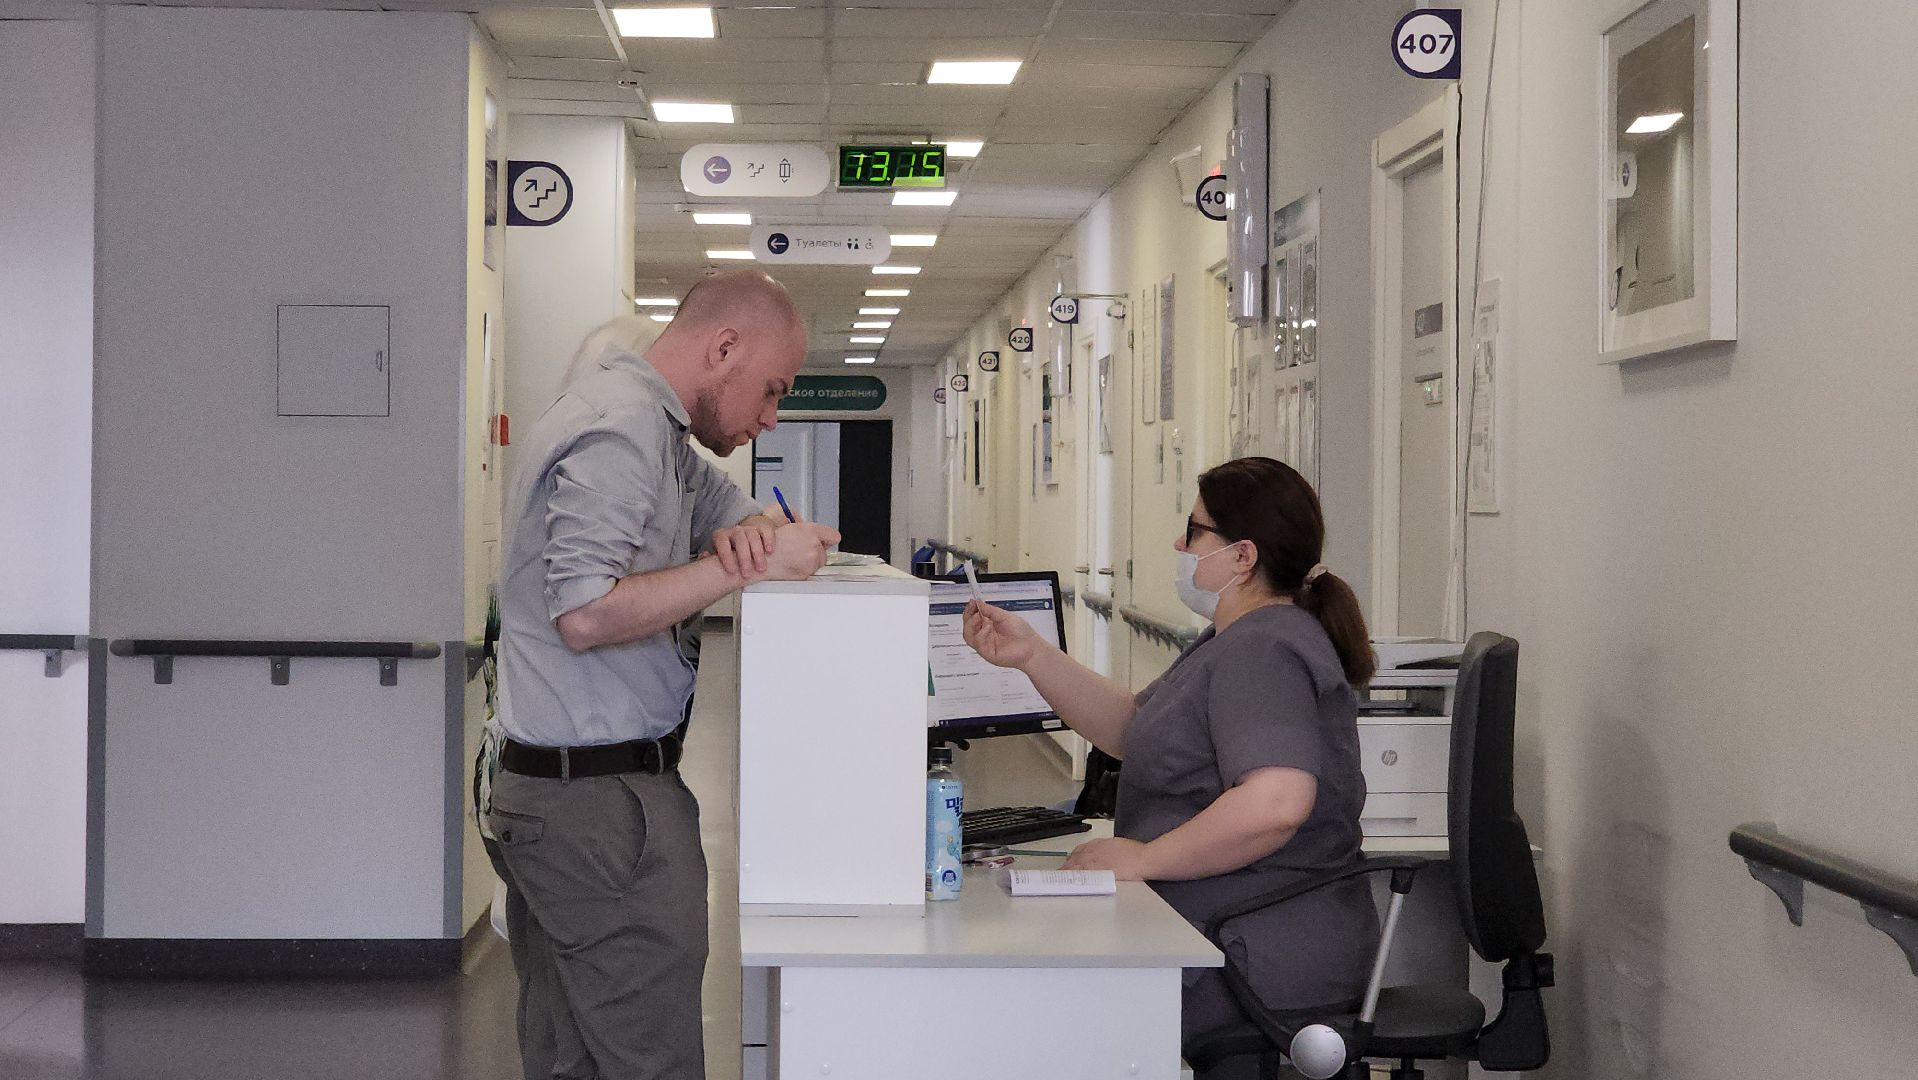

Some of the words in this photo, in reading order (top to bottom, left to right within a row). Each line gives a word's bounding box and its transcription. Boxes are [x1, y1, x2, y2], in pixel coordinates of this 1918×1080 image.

[1400, 34, 1453, 54] 407
[1201, 190, 1226, 203] 40
[796, 238, 842, 248] Туалеты
[1055, 304, 1075, 314] 419
[1011, 336, 1030, 344] 420
[787, 388, 815, 398] ское
[817, 388, 879, 398] отделение
[1382, 750, 1397, 766] hp
